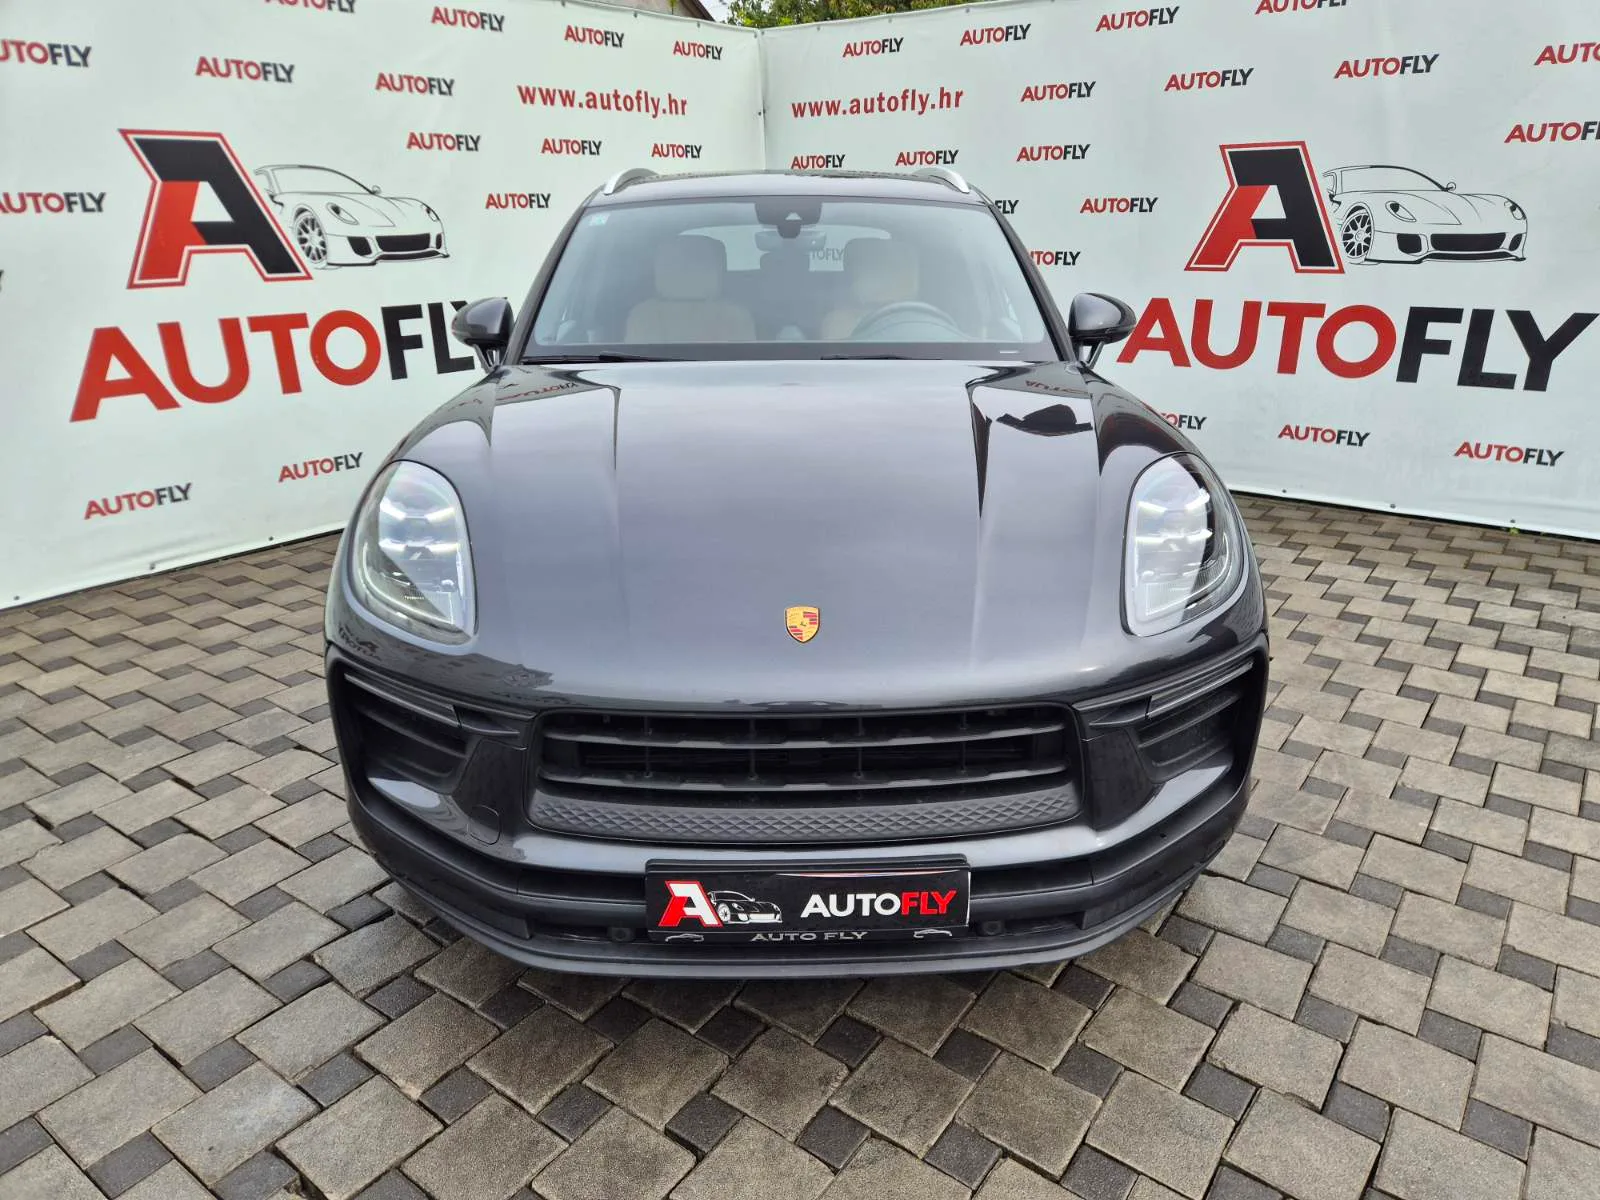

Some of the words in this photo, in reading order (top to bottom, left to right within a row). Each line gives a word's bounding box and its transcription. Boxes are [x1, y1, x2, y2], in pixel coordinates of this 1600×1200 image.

[431, 7, 504, 32] AUTOFLY
[1096, 6, 1180, 32] AUTOFLY
[564, 25, 624, 48] AUTOFLY
[960, 24, 1031, 46] AUTOFLY
[673, 41, 722, 60] AUTOFLY
[843, 37, 904, 57] AUTOFLY
[196, 56, 294, 83] AUTOFLY
[1334, 54, 1439, 79] AUTOFLY
[376, 73, 454, 96] AUTOFLY
[1164, 68, 1254, 91] AUTOFLY
[517, 85, 687, 118] www.autofly.hr
[792, 87, 963, 118] www.autofly.hr
[1021, 81, 1096, 102] AUTOFLY
[407, 132, 480, 151] AUTOFLY
[541, 138, 602, 155] AUTOFLY
[651, 143, 702, 158] AUTOFLY
[1016, 144, 1091, 162] AUTOFLY
[791, 154, 845, 169] AUTOFLY
[896, 150, 959, 166] AUTOFLY
[486, 193, 551, 209] AUTOFLY
[1080, 197, 1158, 213] AUTOFLY
[1030, 251, 1081, 266] TOFLY
[1116, 297, 1600, 392] AUTOFLY
[70, 300, 474, 422] AUTOFL
[1278, 424, 1370, 447] AUTOFLY
[1454, 442, 1564, 467] AUTOFLY
[279, 452, 362, 482] AUTOFLY
[85, 483, 191, 520] AUTOFLY
[800, 890, 957, 918] AUTOFLY
[751, 932, 817, 942] AUTO
[824, 931, 869, 941] FLY
